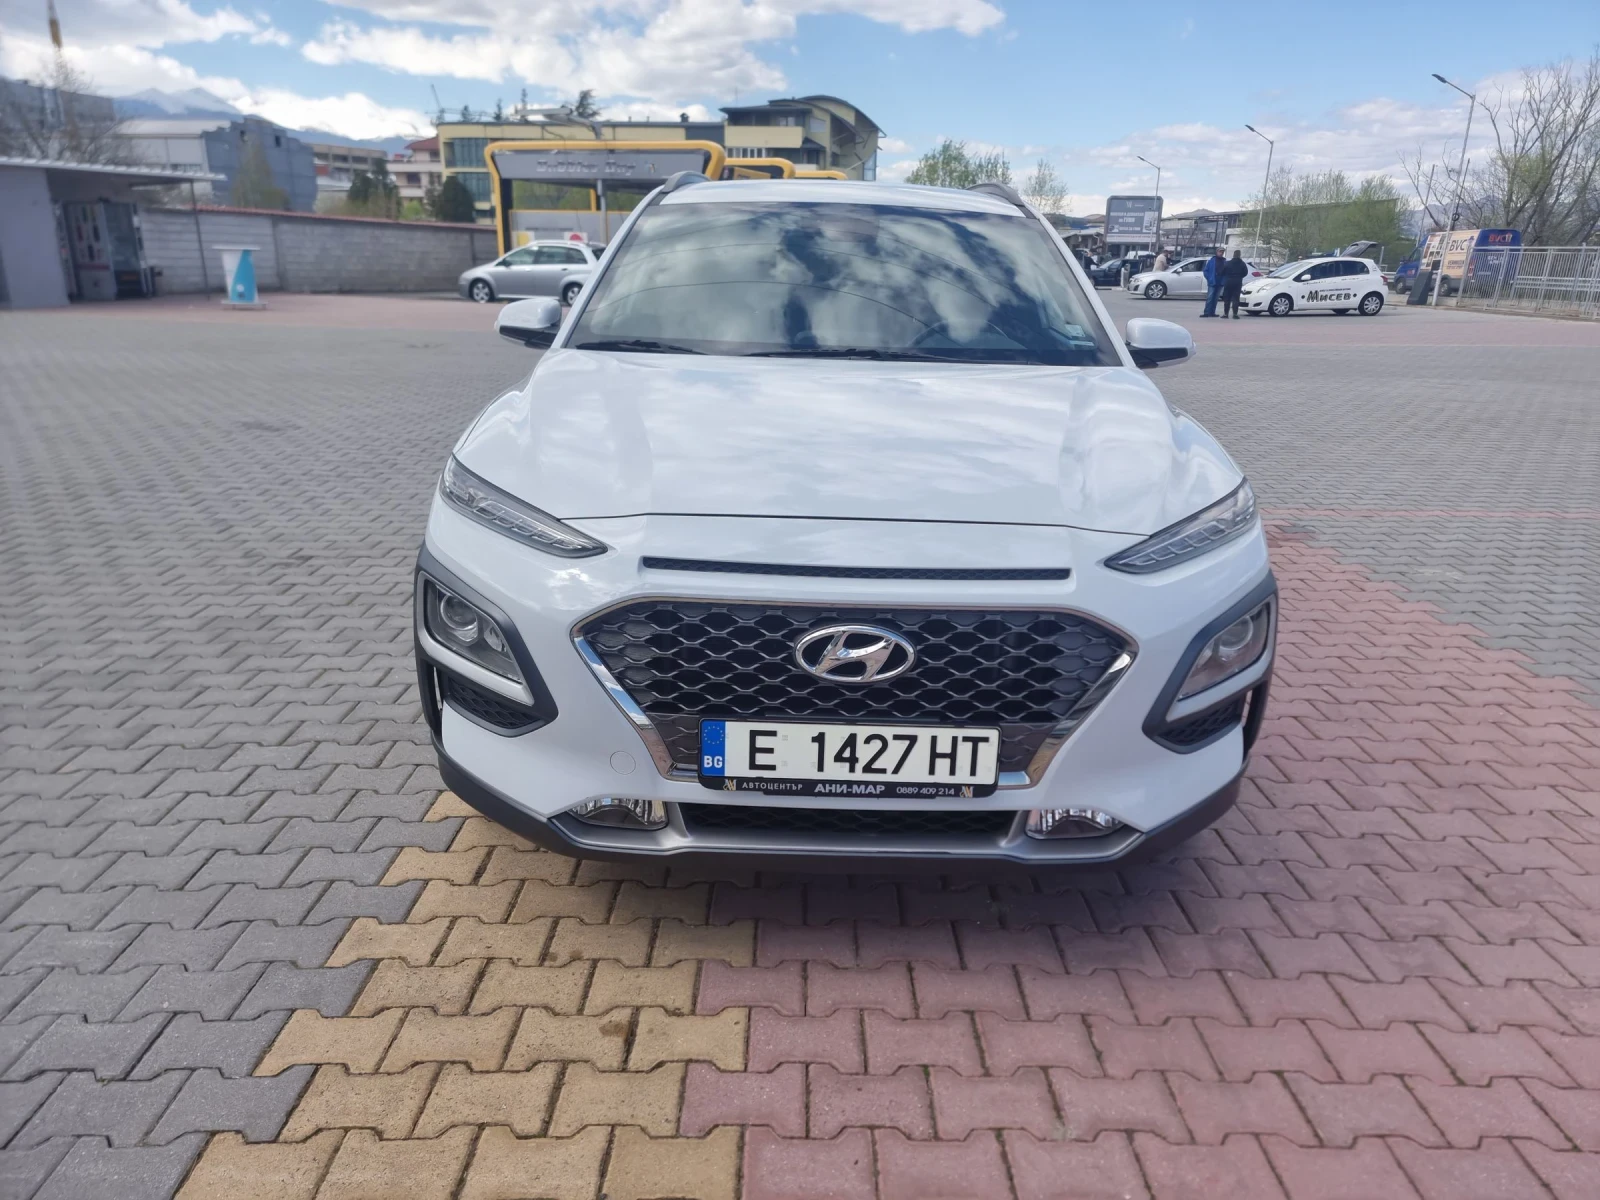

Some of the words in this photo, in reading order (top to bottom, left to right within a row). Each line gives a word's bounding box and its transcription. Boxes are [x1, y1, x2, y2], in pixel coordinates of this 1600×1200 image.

[748, 729, 778, 771] E
[811, 732, 918, 775] 1427
[703, 755, 723, 768] BG
[741, 781, 803, 791] АВТОЦЕНТЪР
[814, 783, 885, 795] АНИ-МАР
[896, 787, 917, 795] 0889
[919, 787, 937, 795] 409
[938, 788, 955, 796] 214
